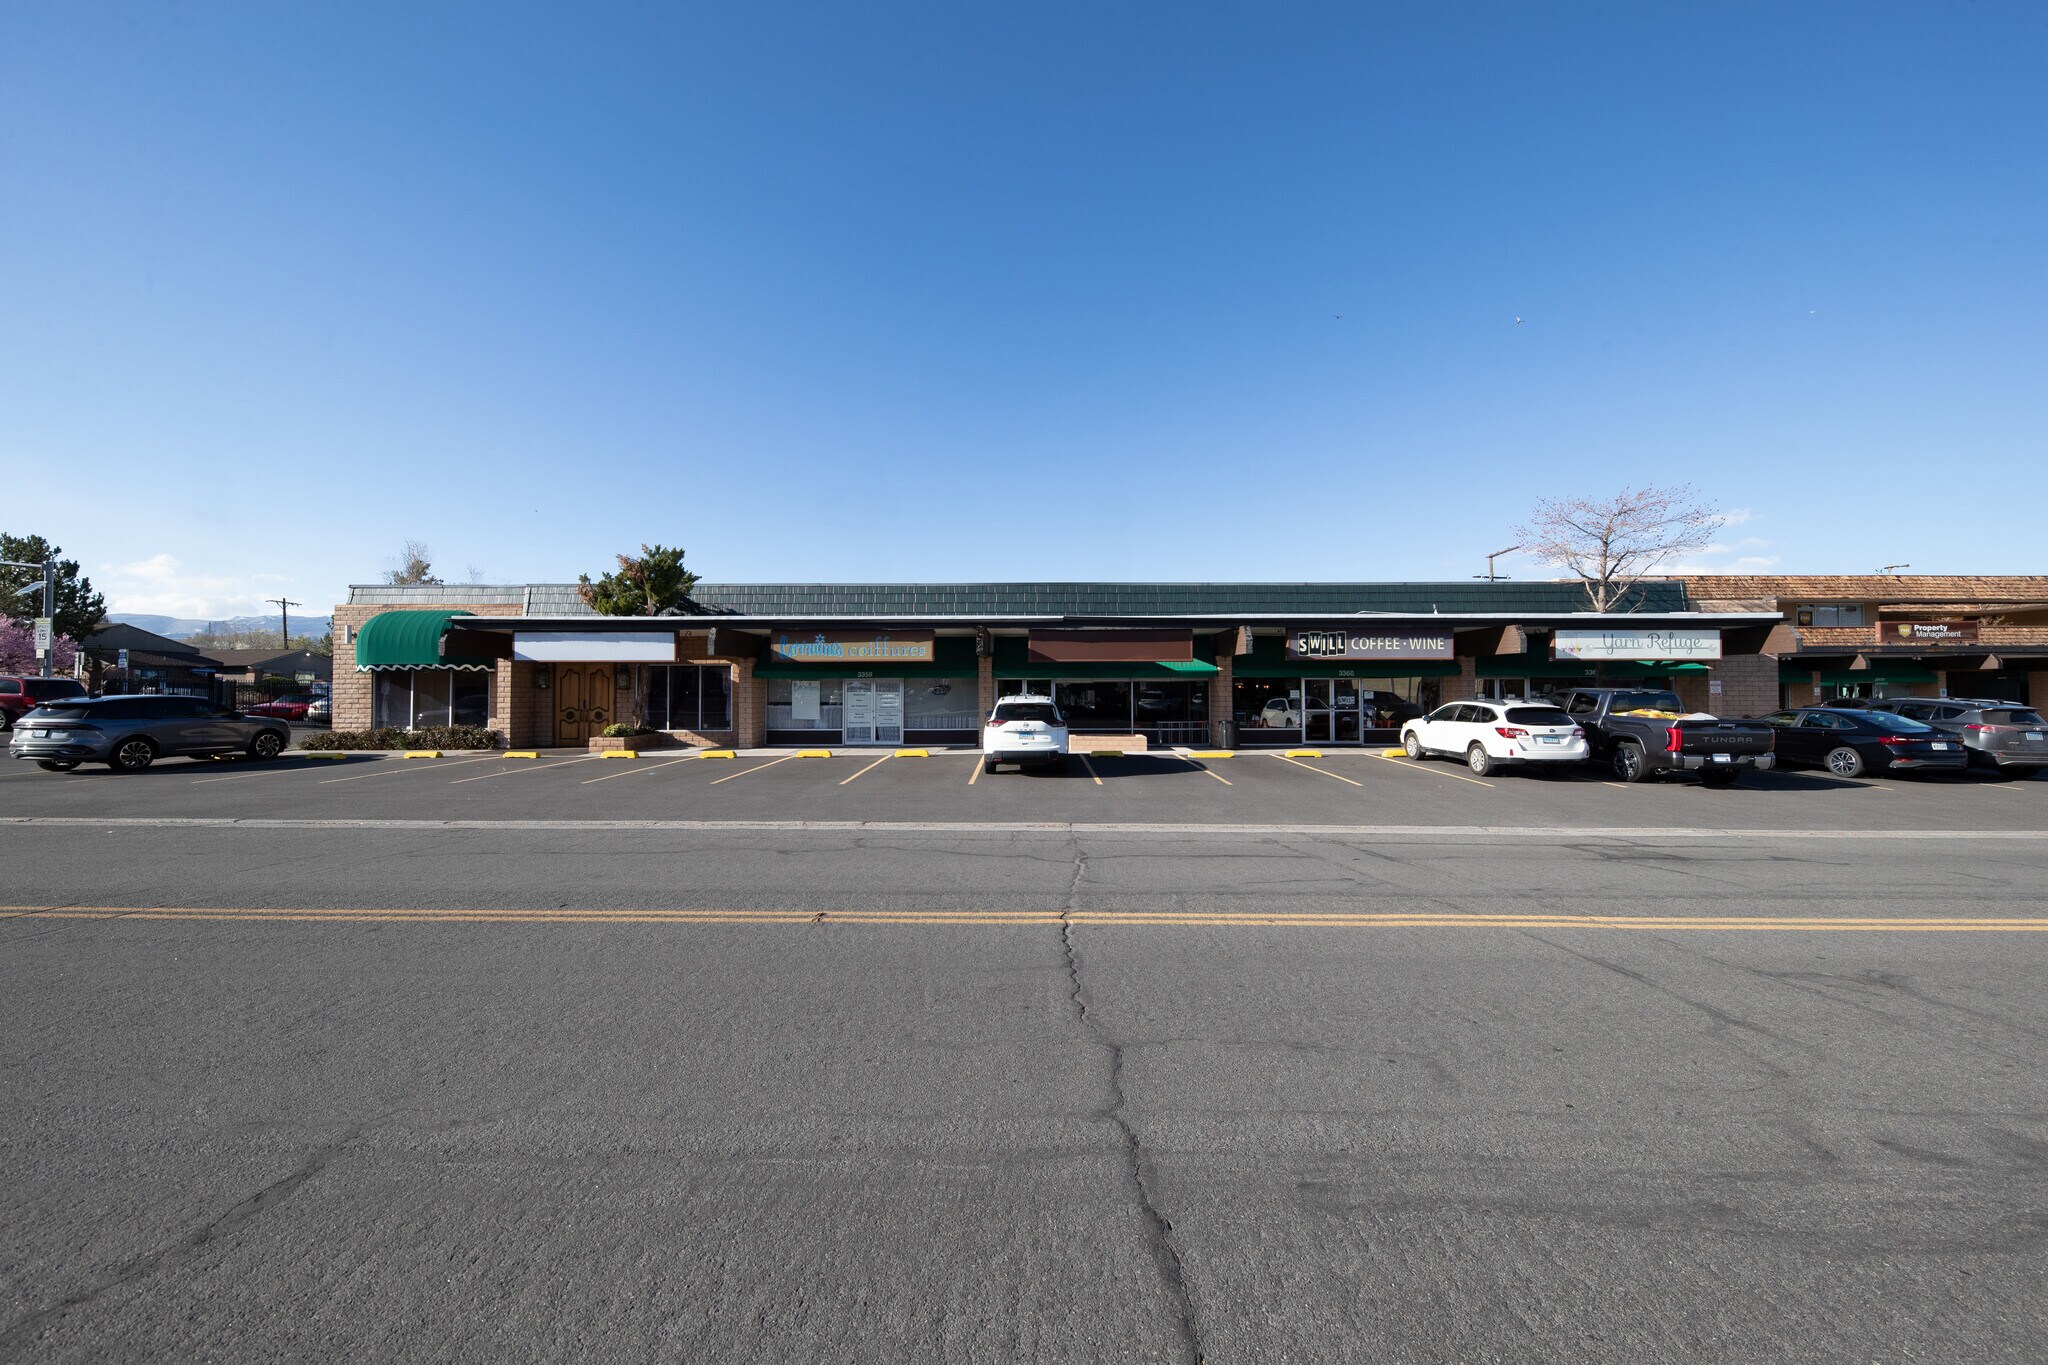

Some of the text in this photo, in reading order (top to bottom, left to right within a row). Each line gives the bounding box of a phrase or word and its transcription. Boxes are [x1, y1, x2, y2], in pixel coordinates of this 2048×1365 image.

[848, 636, 926, 657] coiffures
[1299, 632, 1445, 653] SWILL COFFEE WINE
[1602, 632, 1702, 655] Yarn Refuge
